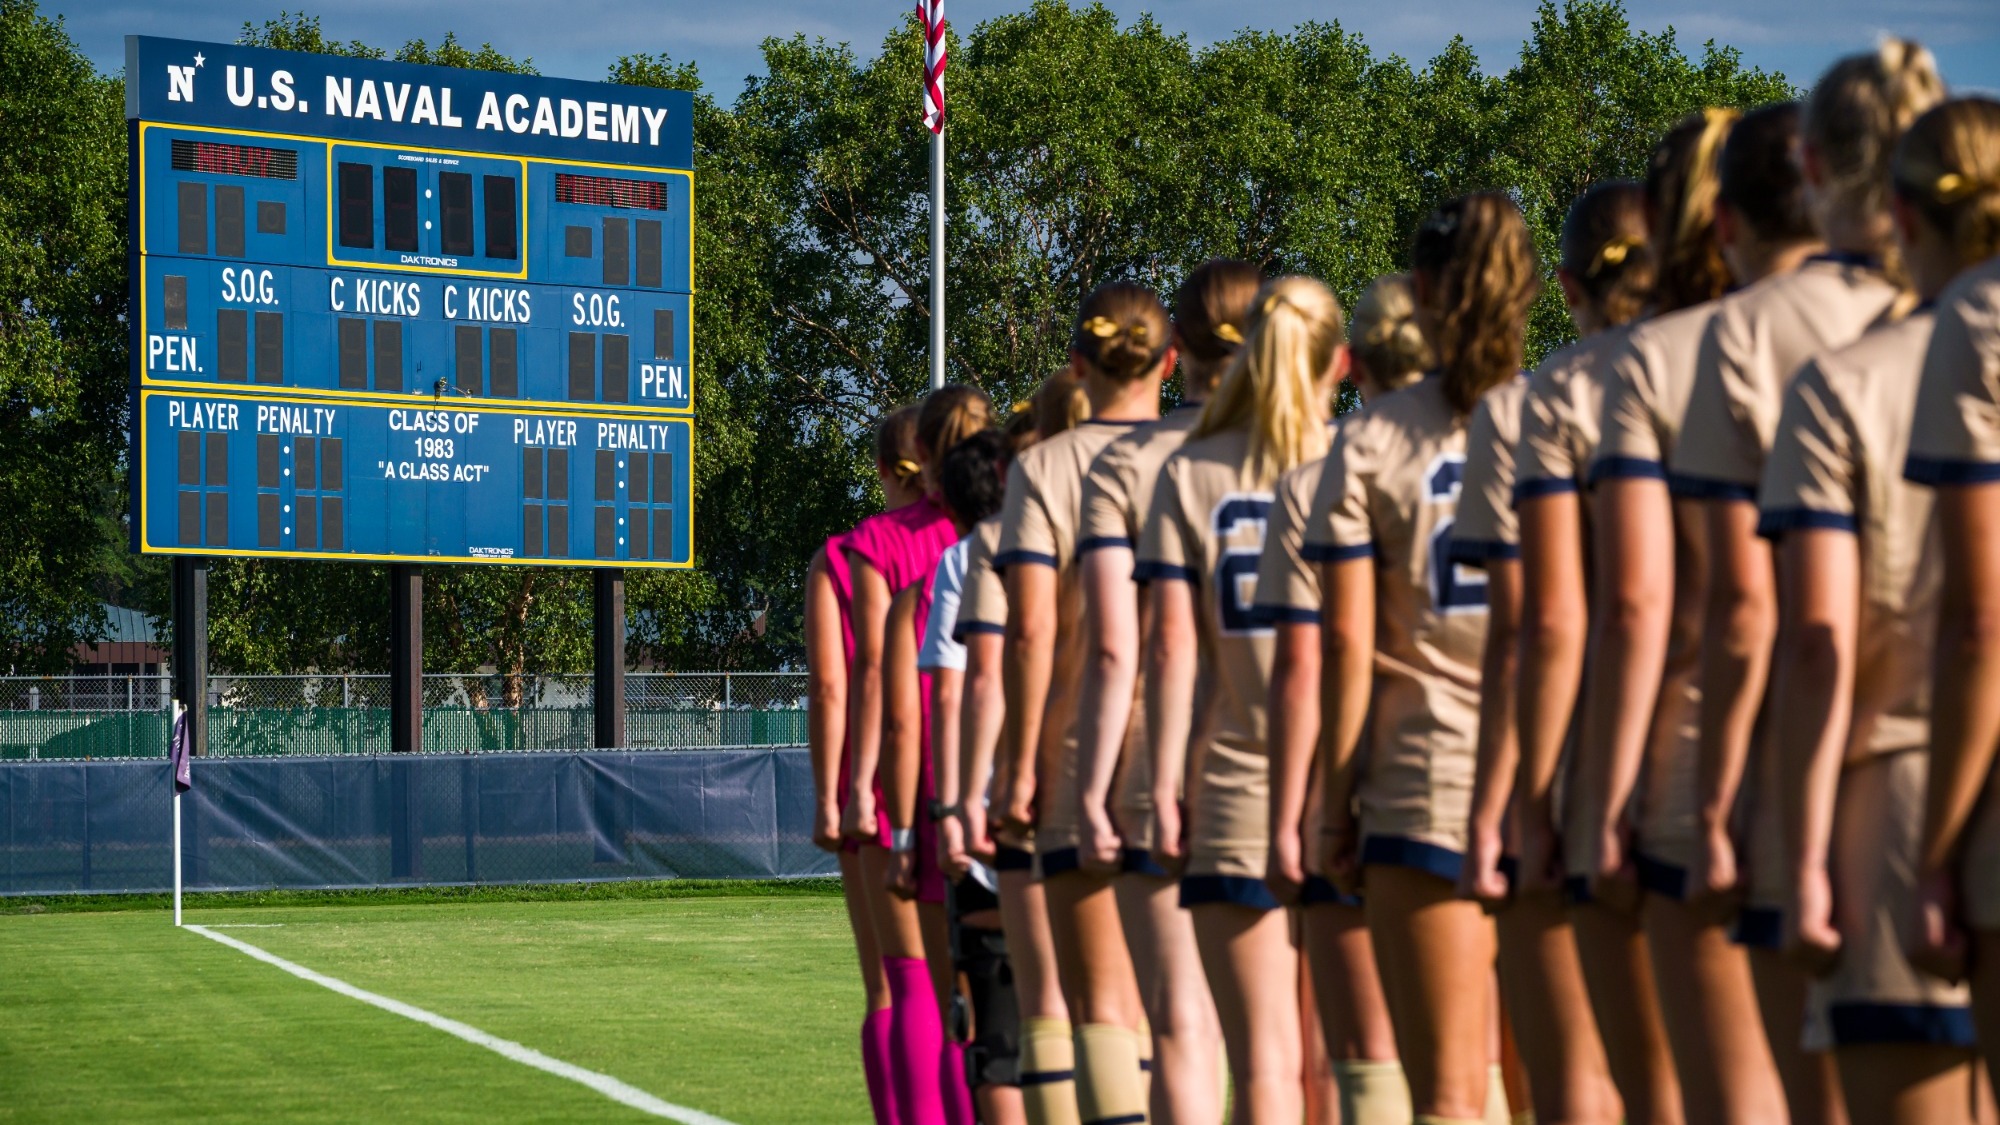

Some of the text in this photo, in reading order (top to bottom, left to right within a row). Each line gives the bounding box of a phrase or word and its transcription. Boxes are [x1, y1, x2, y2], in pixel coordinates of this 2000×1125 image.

[227, 66, 667, 145] U.S. NAVAL ACADEMY
[197, 142, 272, 178] NAVY
[402, 255, 457, 268] DAKTRONICS
[222, 268, 278, 304] S.O.G.
[331, 277, 420, 316] C KICKS
[445, 286, 530, 322] C KICKS
[573, 293, 624, 327] S.O.G.
[150, 336, 202, 372] PEN.
[642, 365, 687, 398] PEN.
[170, 401, 238, 430] PLAYER
[258, 406, 335, 434] PENALTY
[389, 410, 478, 433] CLASS OF
[515, 419, 576, 445] PLAYER
[598, 423, 668, 449] PENALTY
[415, 438, 453, 458] 1983
[379, 462, 489, 481] "A CLASS ACT"
[470, 547, 513, 555] DAKTRONICS
